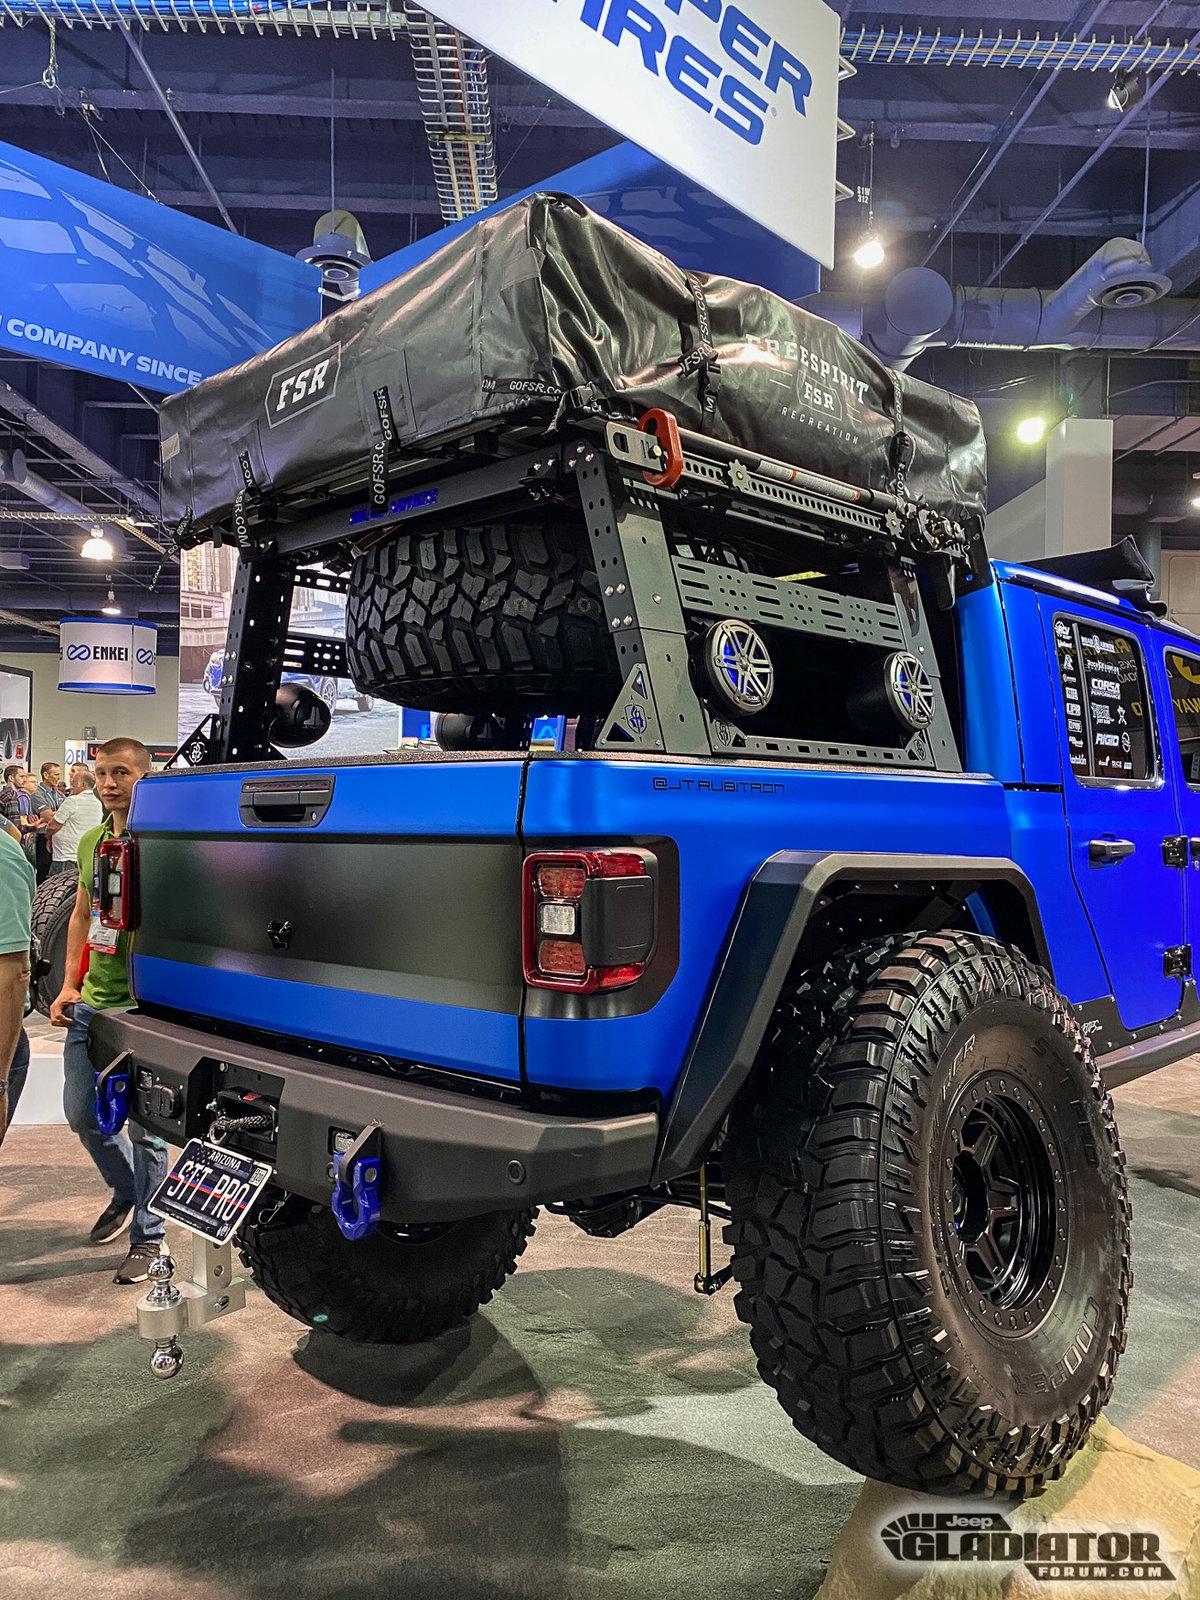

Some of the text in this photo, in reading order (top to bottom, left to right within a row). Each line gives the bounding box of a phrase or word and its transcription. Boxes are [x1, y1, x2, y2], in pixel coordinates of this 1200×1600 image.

[553, 0, 770, 146] IRES
[6, 317, 202, 386] COMPANY SINCE
[275, 358, 331, 413] FSR
[803, 382, 835, 411] FSR
[781, 406, 859, 445] RECREATION
[92, 646, 129, 662] ENKEI
[1091, 677, 1120, 694] CORSA
[208, 1150, 242, 1171] ARIZONA
[166, 1160, 214, 1205] STT
[200, 1173, 251, 1221] PRO
